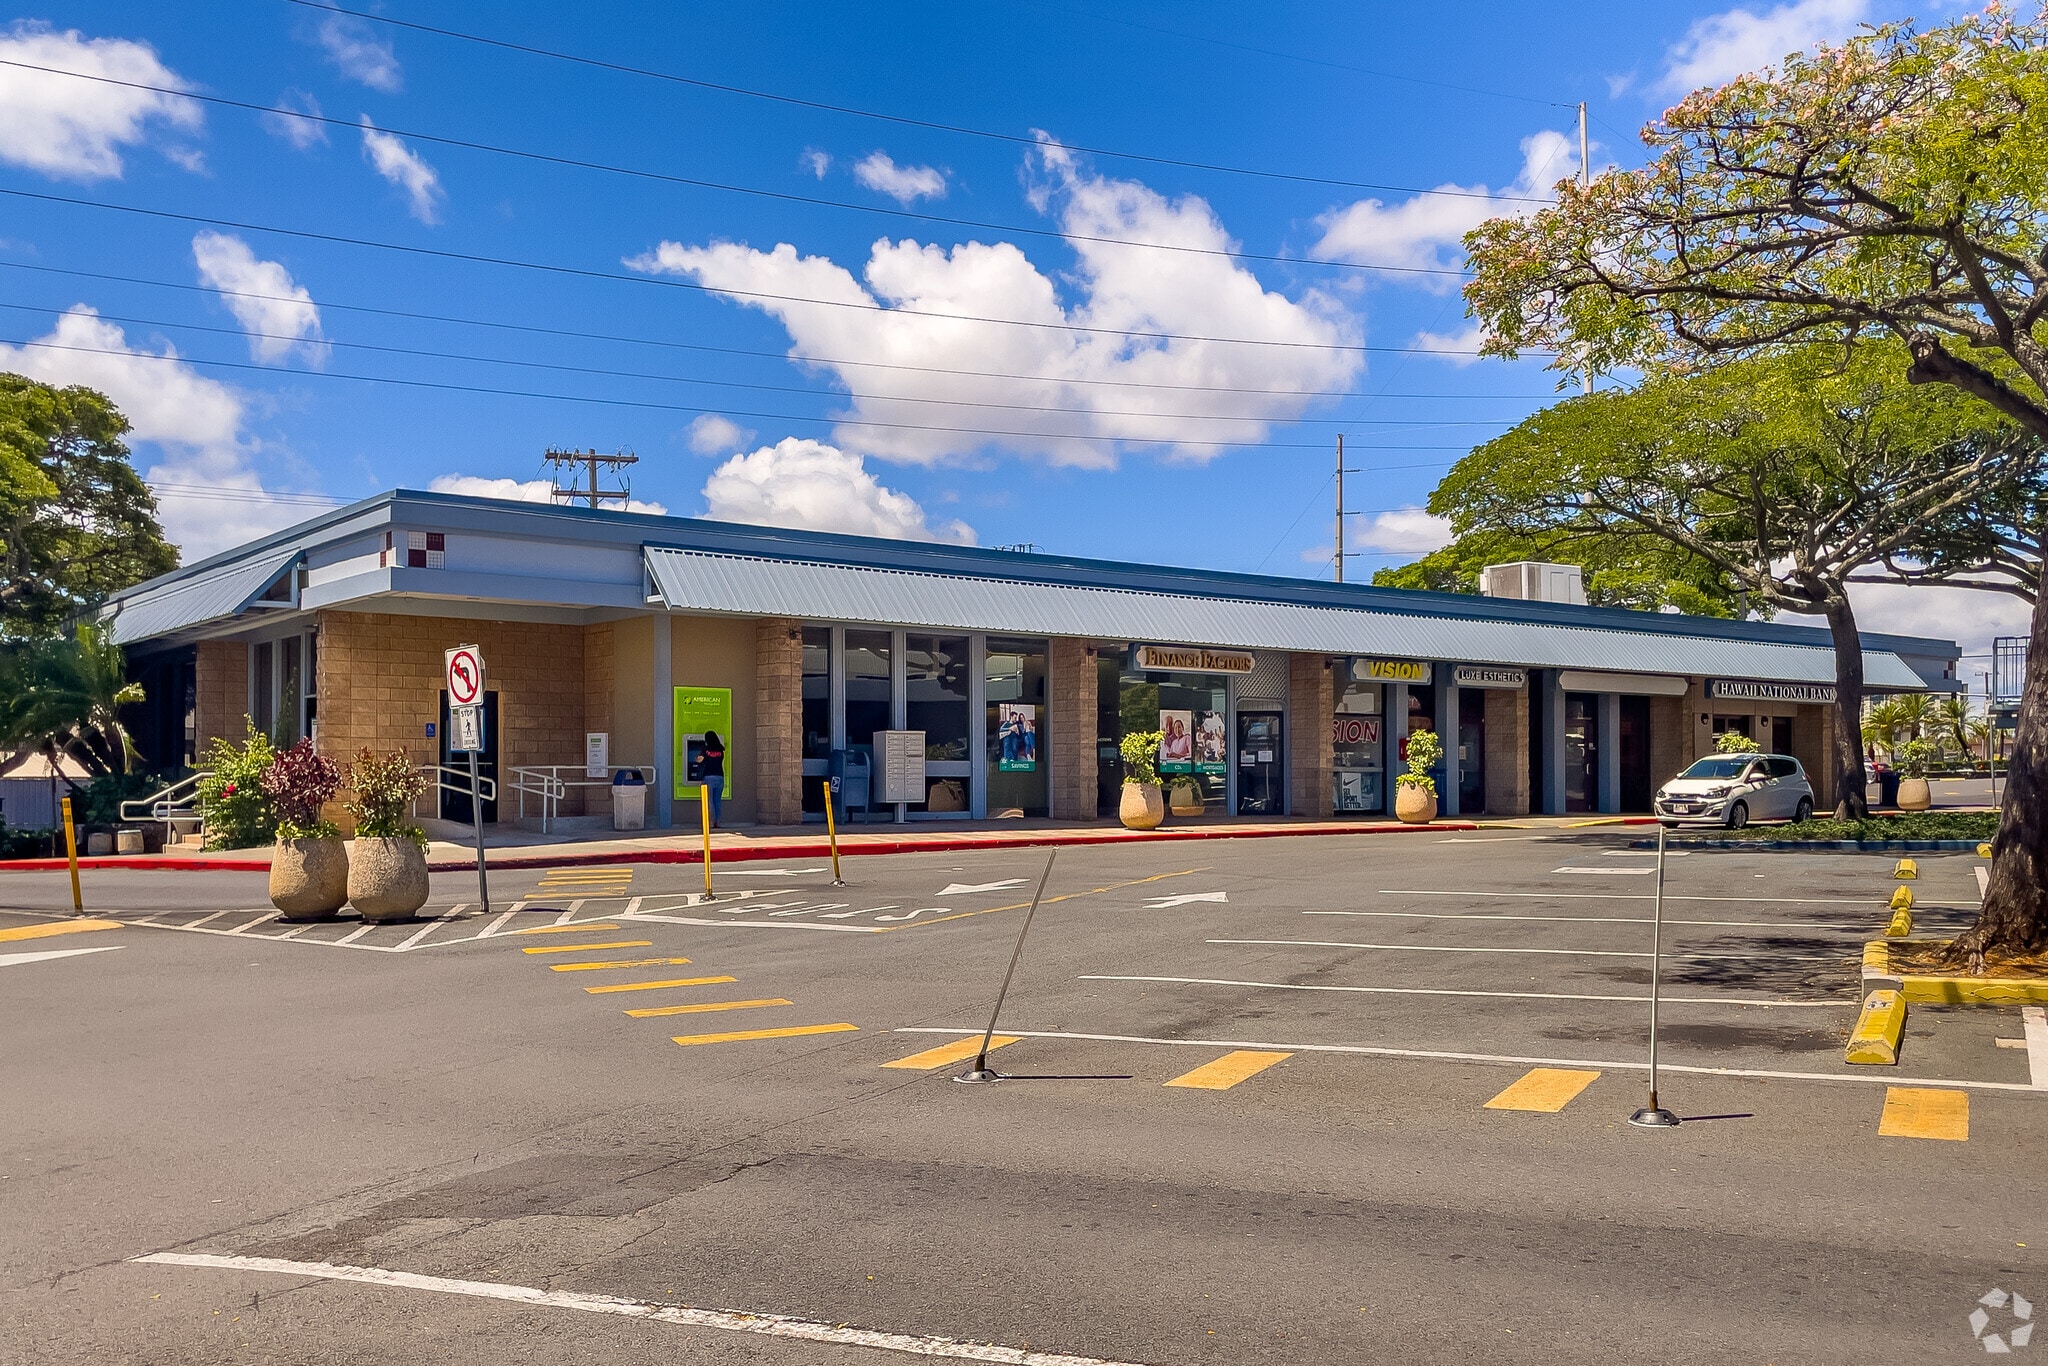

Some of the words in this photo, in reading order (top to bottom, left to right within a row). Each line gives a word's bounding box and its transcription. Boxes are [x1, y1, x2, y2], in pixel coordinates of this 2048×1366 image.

[1145, 648, 1200, 668] FINANCE
[1200, 650, 1251, 671] FACTORS
[1368, 660, 1423, 679] VISION
[1460, 669, 1482, 681] LUXE
[1484, 671, 1525, 683] ESTHETICS
[1720, 682, 1758, 697] HAWAII
[1759, 684, 1808, 699] NATIONAL
[1810, 686, 1837, 701] BANK
[460, 708, 474, 718] STOP
[717, 901, 952, 921] STOP
